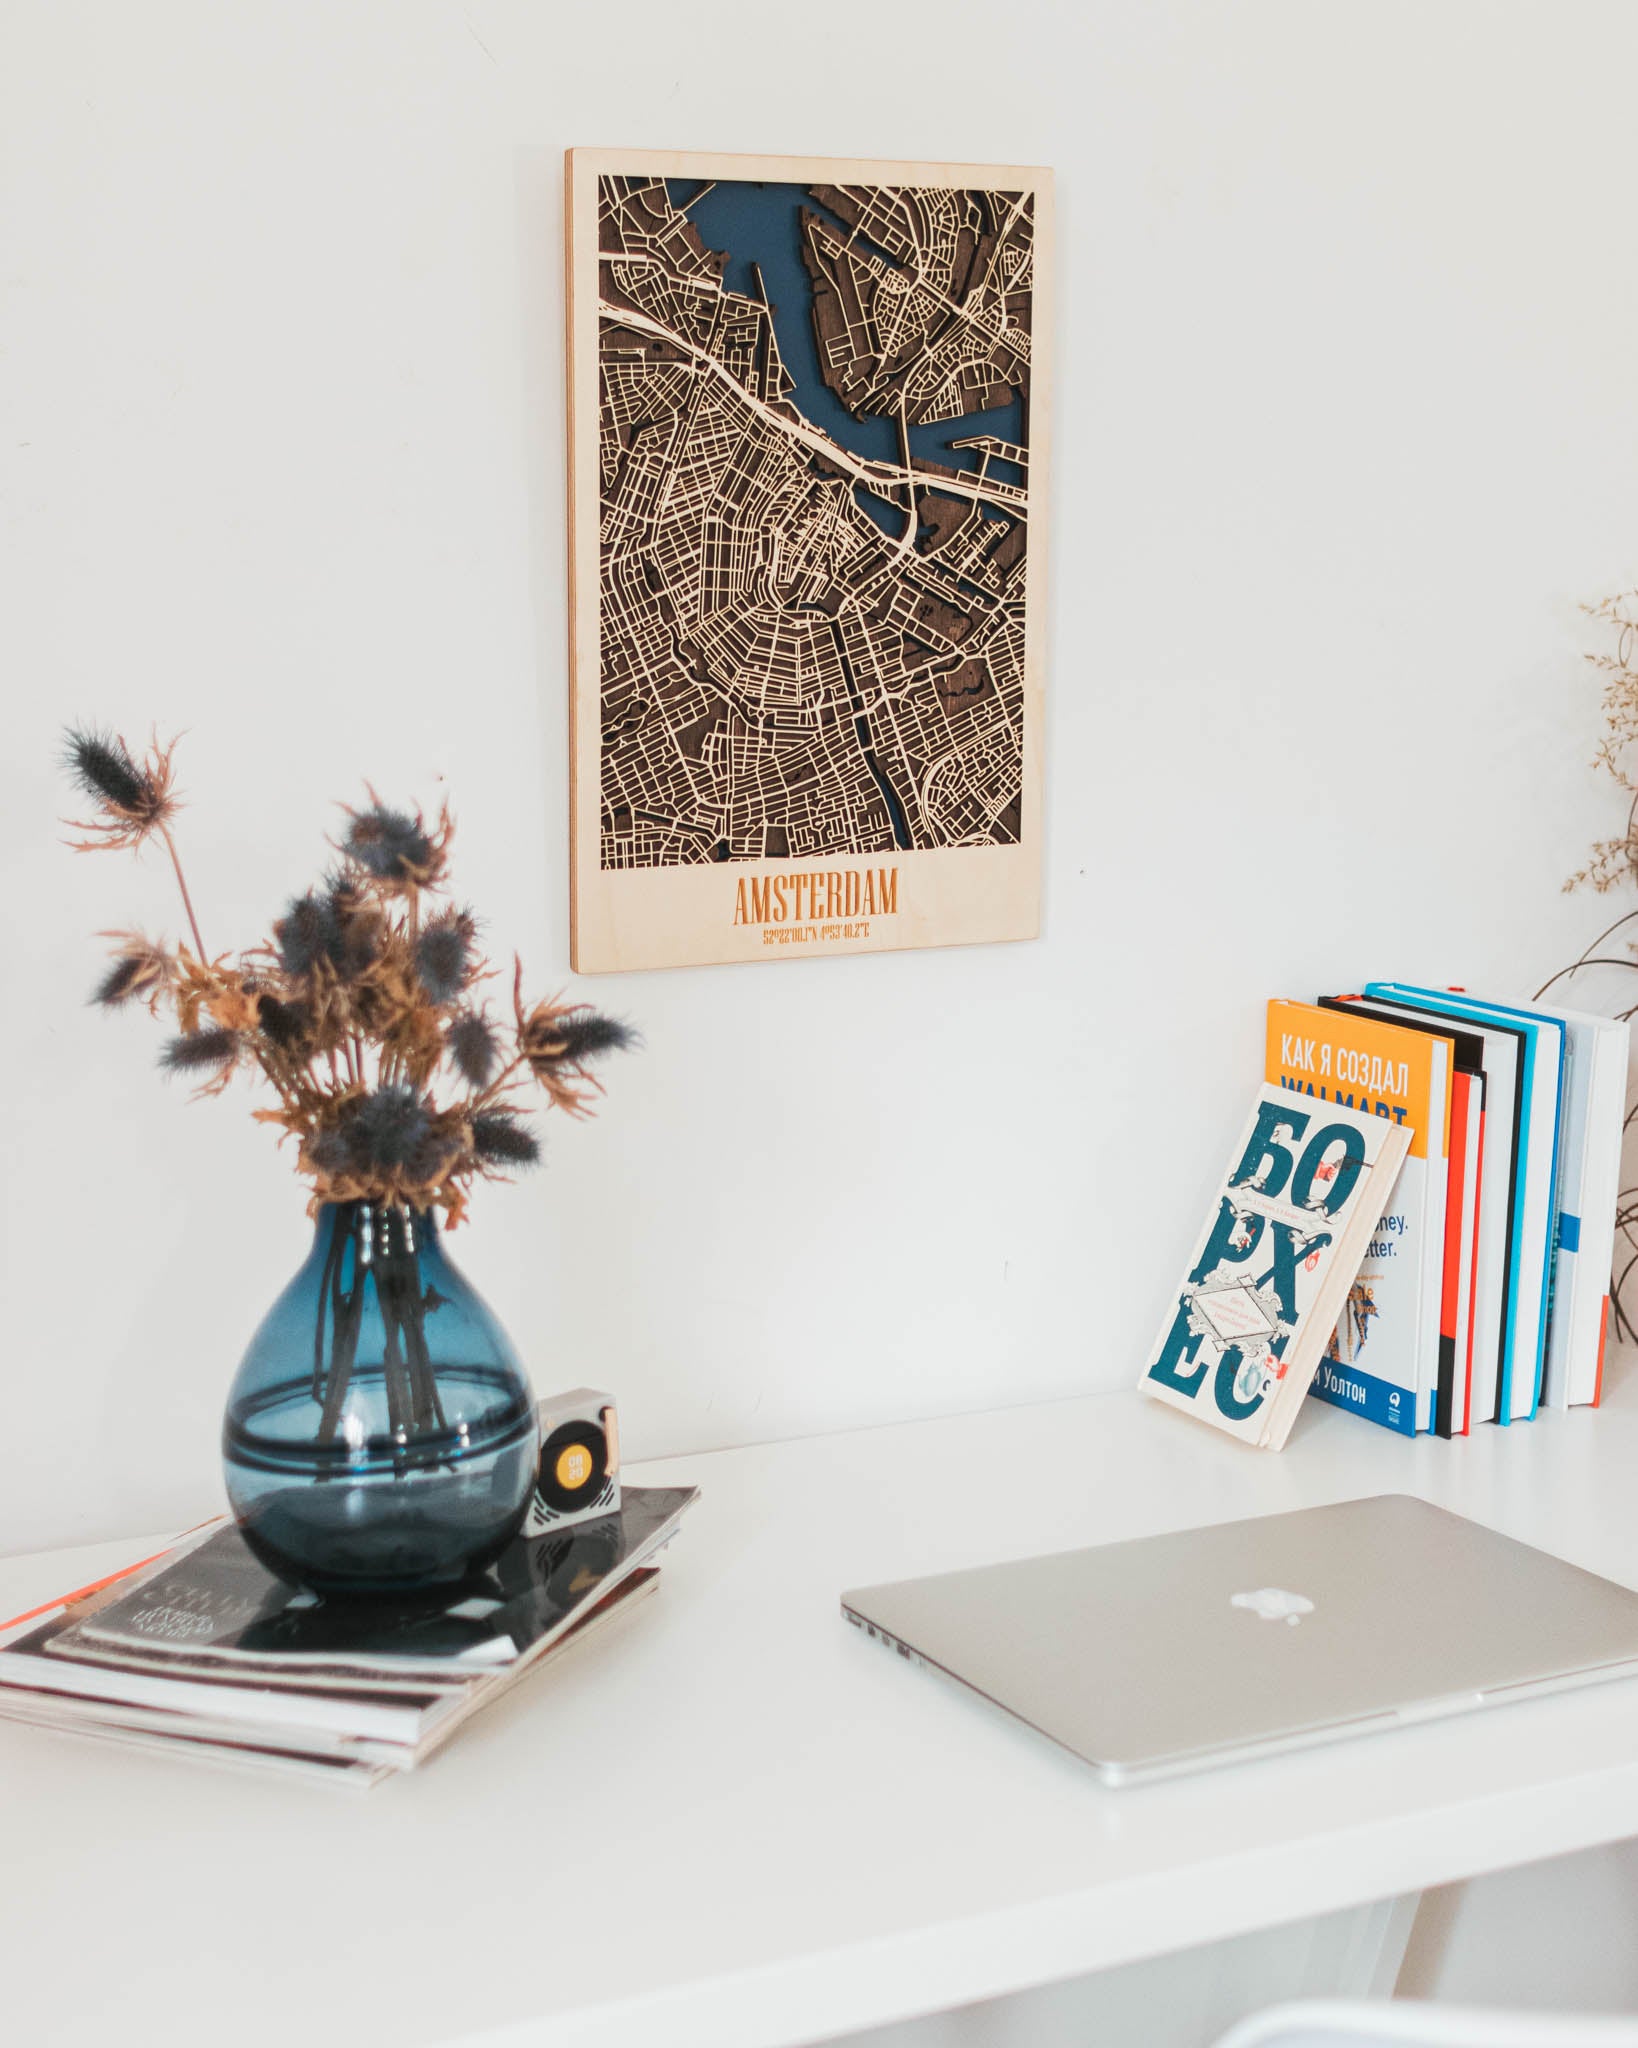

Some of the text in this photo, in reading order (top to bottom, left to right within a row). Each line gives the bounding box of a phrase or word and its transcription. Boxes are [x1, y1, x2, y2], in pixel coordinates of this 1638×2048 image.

[733, 867, 898, 926] AMSTERDAM
[1281, 1033, 1409, 1097] КАК Я СОЗДАЛ
[1228, 1100, 1366, 1217] БО
[1188, 1195, 1332, 1327] РХ
[1374, 1215, 1408, 1235] ney.
[1147, 1292, 1292, 1421] ЕС
